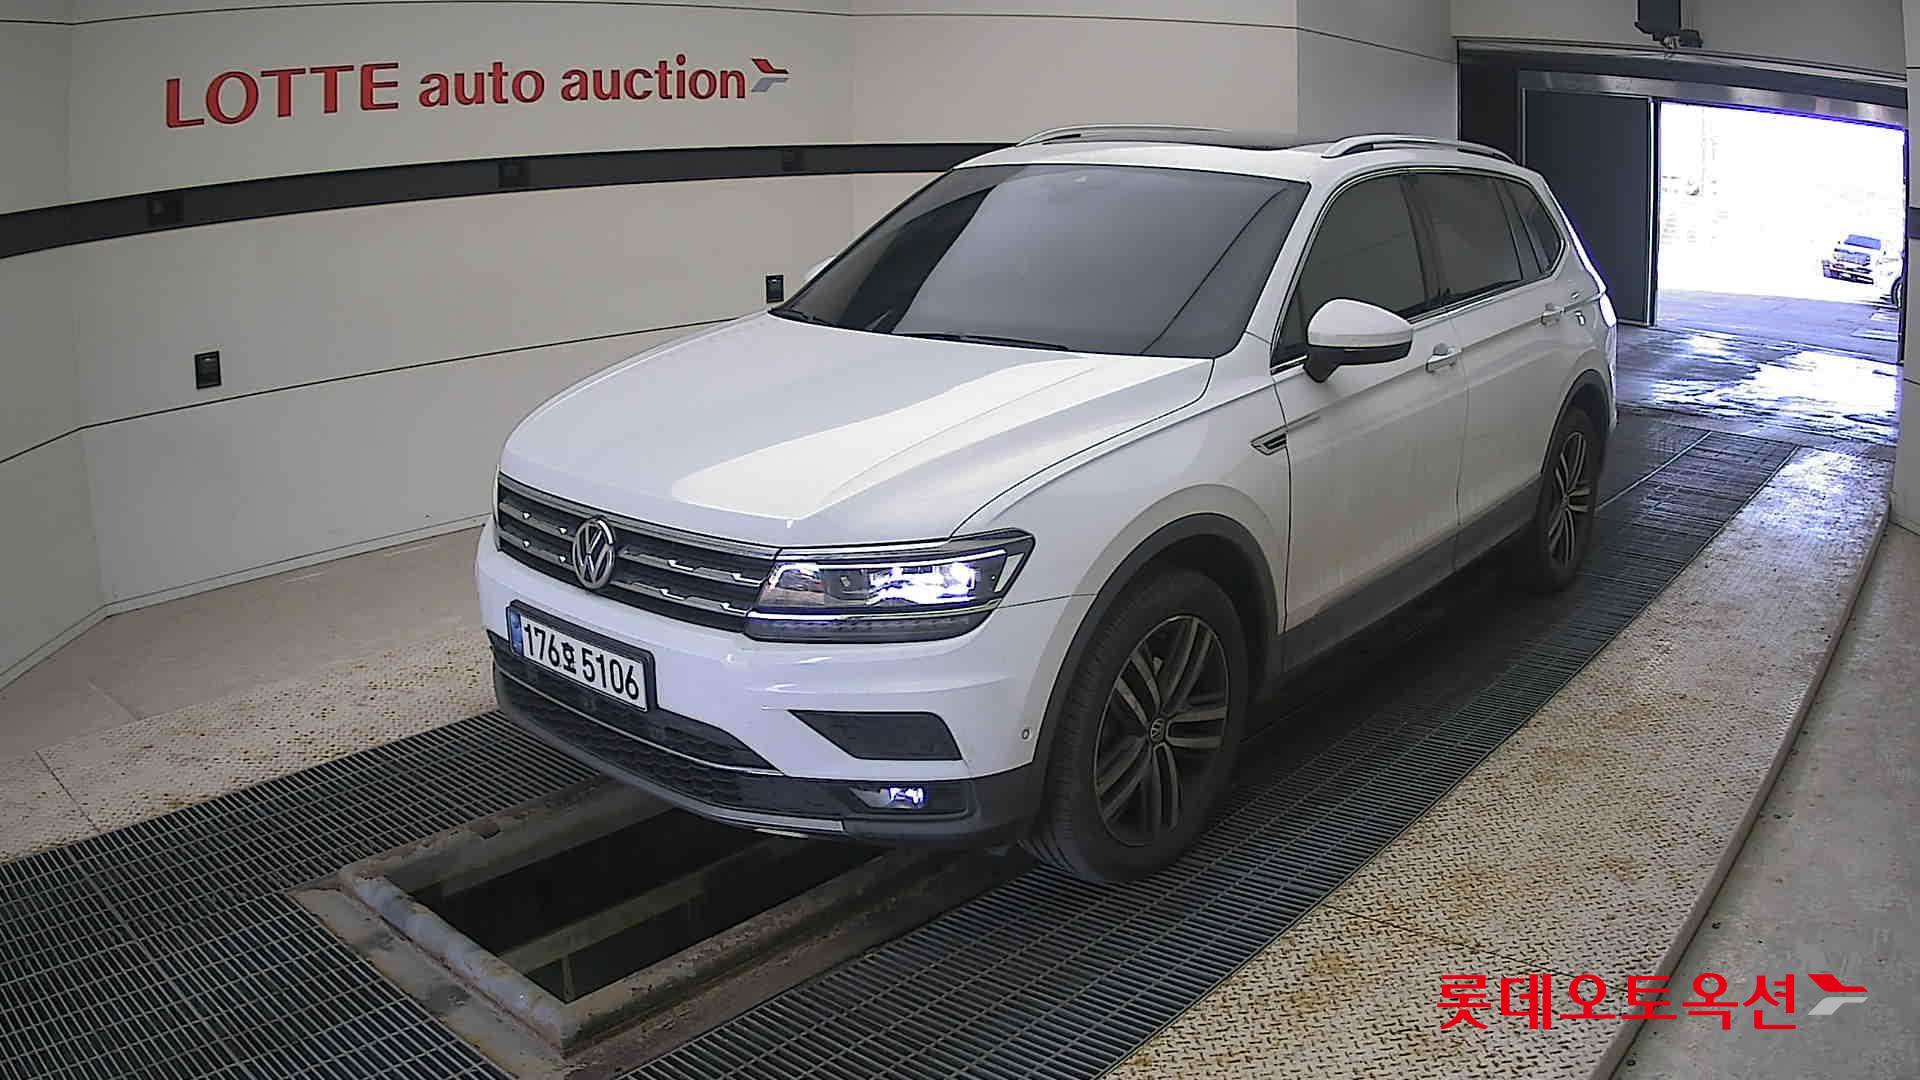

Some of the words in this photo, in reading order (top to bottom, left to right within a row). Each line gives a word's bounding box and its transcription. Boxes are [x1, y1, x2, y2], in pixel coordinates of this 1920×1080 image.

[166, 62, 399, 128] LOTTE
[418, 61, 546, 107] auto
[560, 54, 746, 101] auction
[581, 647, 639, 700] 5106
